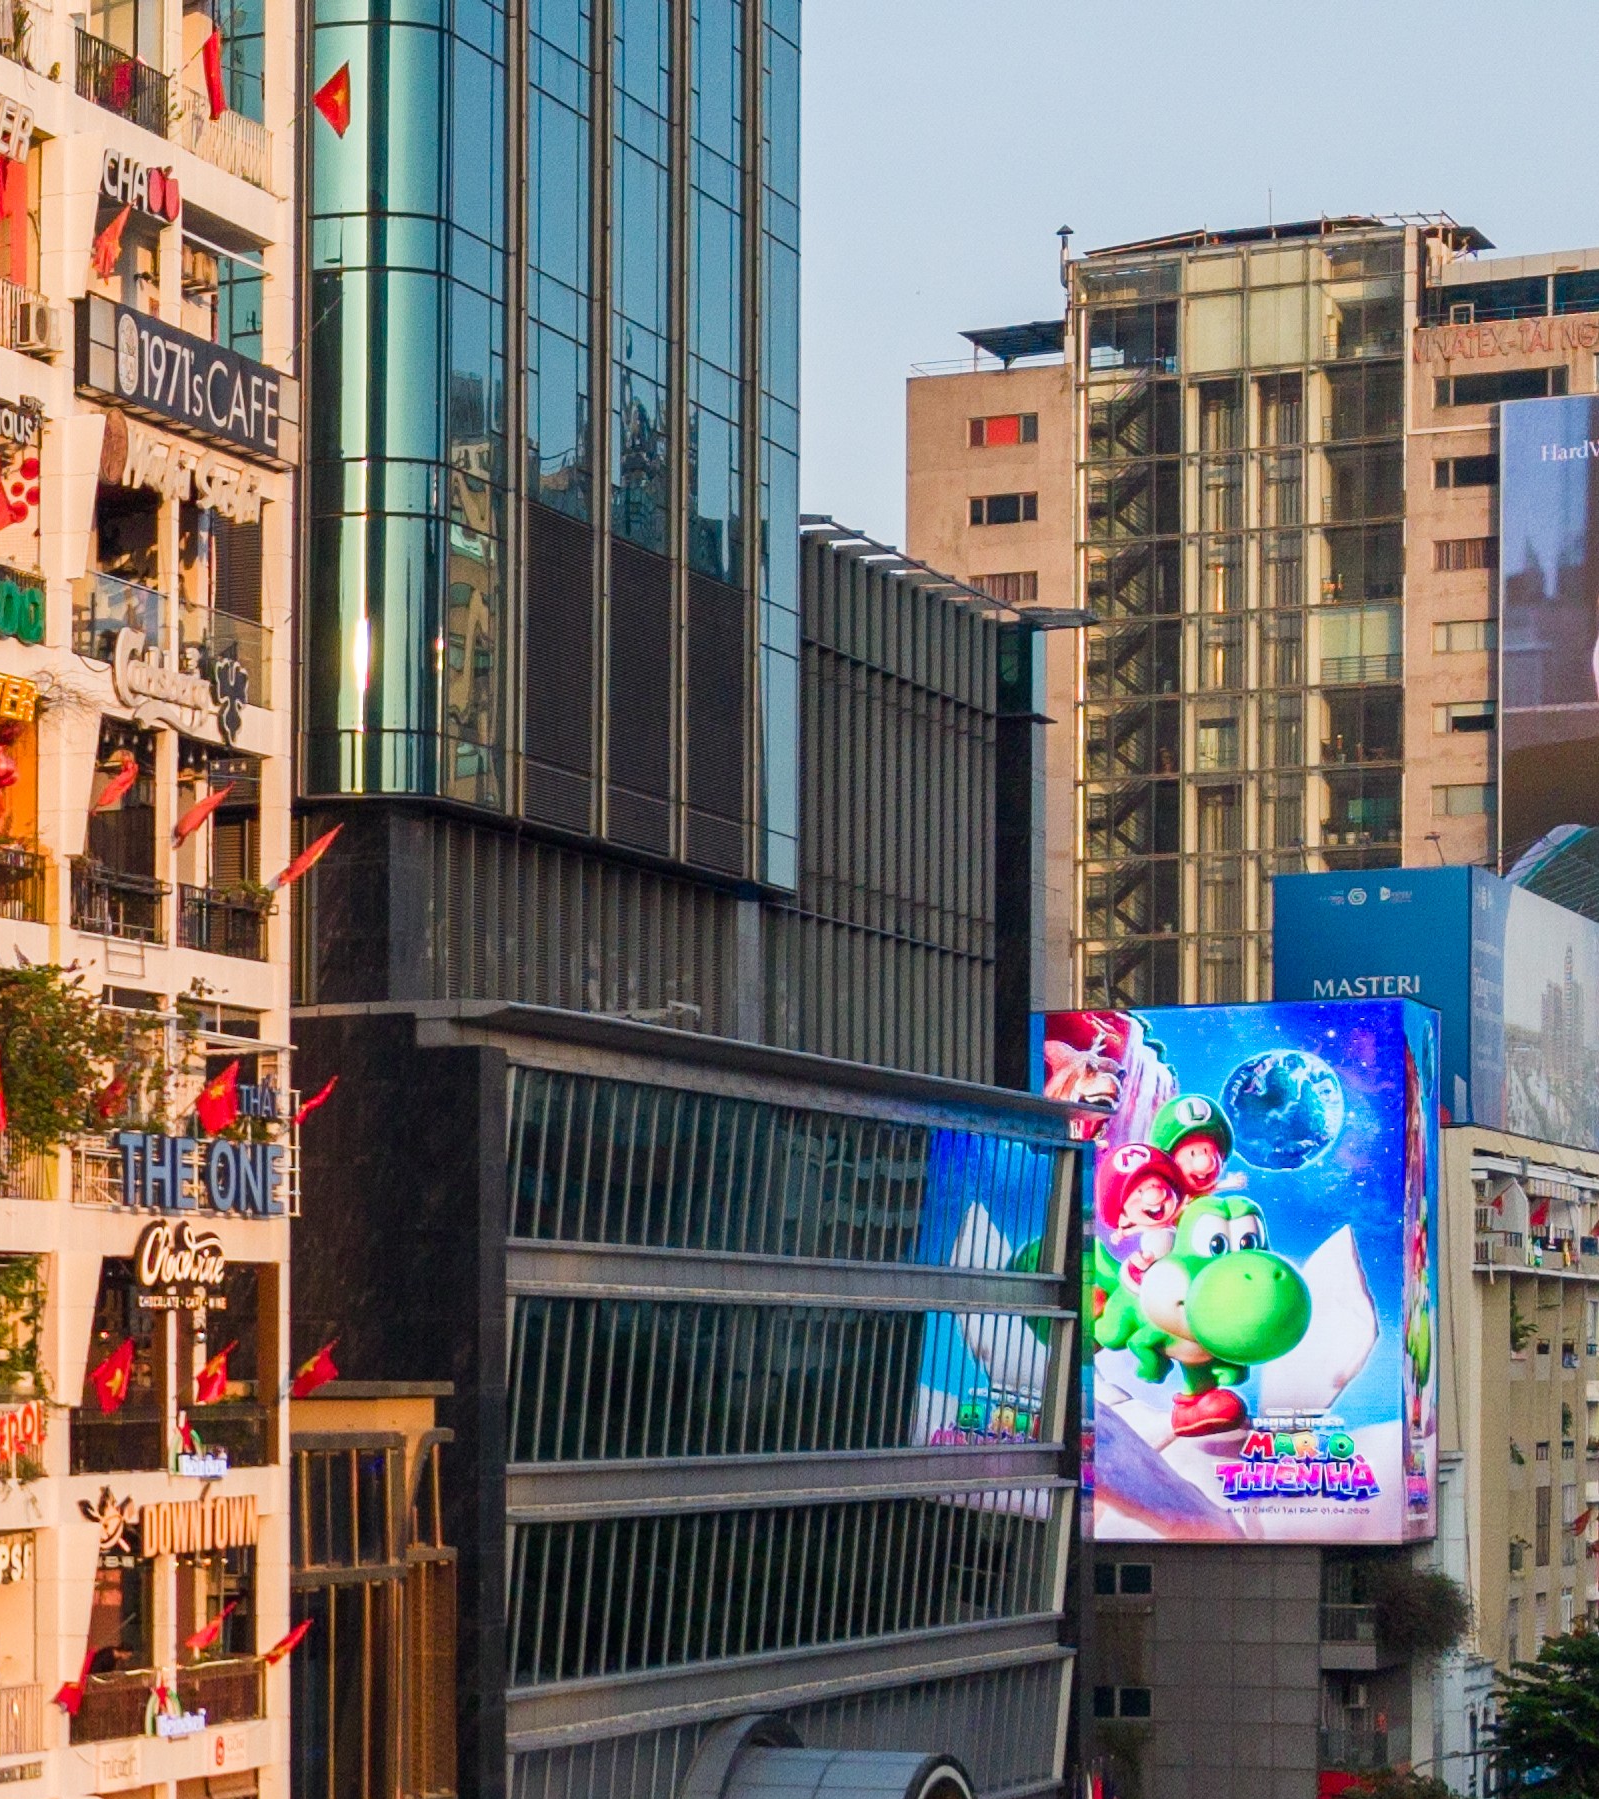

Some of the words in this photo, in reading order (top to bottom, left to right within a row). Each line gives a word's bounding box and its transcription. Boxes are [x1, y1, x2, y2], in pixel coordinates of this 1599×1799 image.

[140, 330, 203, 418] 1971's
[206, 361, 280, 449] CAFE
[1313, 974, 1421, 999] MASTERI
[118, 1131, 197, 1210] THE
[210, 1138, 285, 1215] ONE
[1240, 1431, 1356, 1463] MARIO
[1214, 1456, 1324, 1503] THIÊN
[1324, 1454, 1383, 1502] HÀ
[143, 1494, 258, 1558] DOWNTOWN
